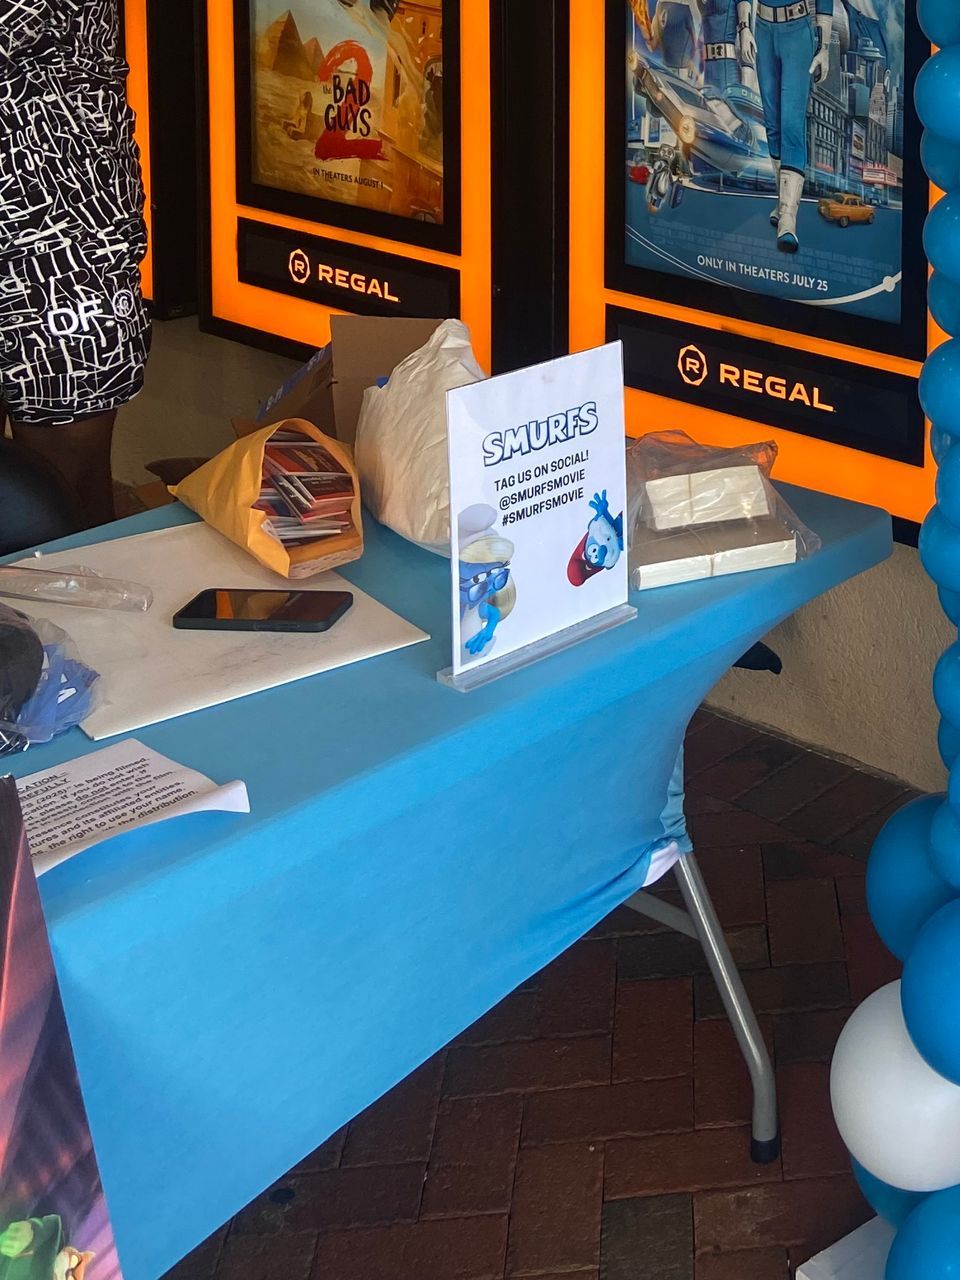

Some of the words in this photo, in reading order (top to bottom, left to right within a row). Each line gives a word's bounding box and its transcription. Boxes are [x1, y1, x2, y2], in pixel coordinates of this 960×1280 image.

[314, 39, 390, 161] 2
[332, 75, 371, 107] BAD
[324, 103, 372, 137] GUYS
[321, 169, 353, 183] THEATERS
[354, 176, 379, 190] AUGUST
[318, 263, 399, 302] REGAL
[697, 254, 723, 272] ONLY
[725, 260, 736, 272] IN
[739, 263, 790, 283] THEATERS
[791, 273, 815, 290] JULY
[816, 278, 829, 292] 25
[719, 362, 835, 413] REGAL
[482, 401, 599, 467] SMURFS
[494, 475, 516, 492] TAG
[517, 469, 532, 484] US
[534, 463, 549, 478] ON
[550, 449, 589, 473] SOCIAL!
[499, 468, 586, 511] @SMURFSMOVIE
[502, 487, 585, 527] #SMURFSMOVIE
[71, 787, 90, 797] you
[108, 773, 125, 782] not
[126, 763, 150, 773] wish
[80, 787, 121, 805] consent
[85, 771, 115, 784] being
[39, 800, 73, 816] please
[75, 793, 89, 801] do
[90, 785, 109, 794] not
[61, 823, 81, 835] and
[82, 817, 97, 825] its
[98, 797, 142, 819] affiliated
[75, 796, 132, 820] constitutes
[133, 785, 156, 797] your
[48, 839, 67, 850] the
[68, 826, 95, 841] right
[95, 821, 107, 829] to
[108, 812, 128, 823] use
[129, 800, 153, 815] your
